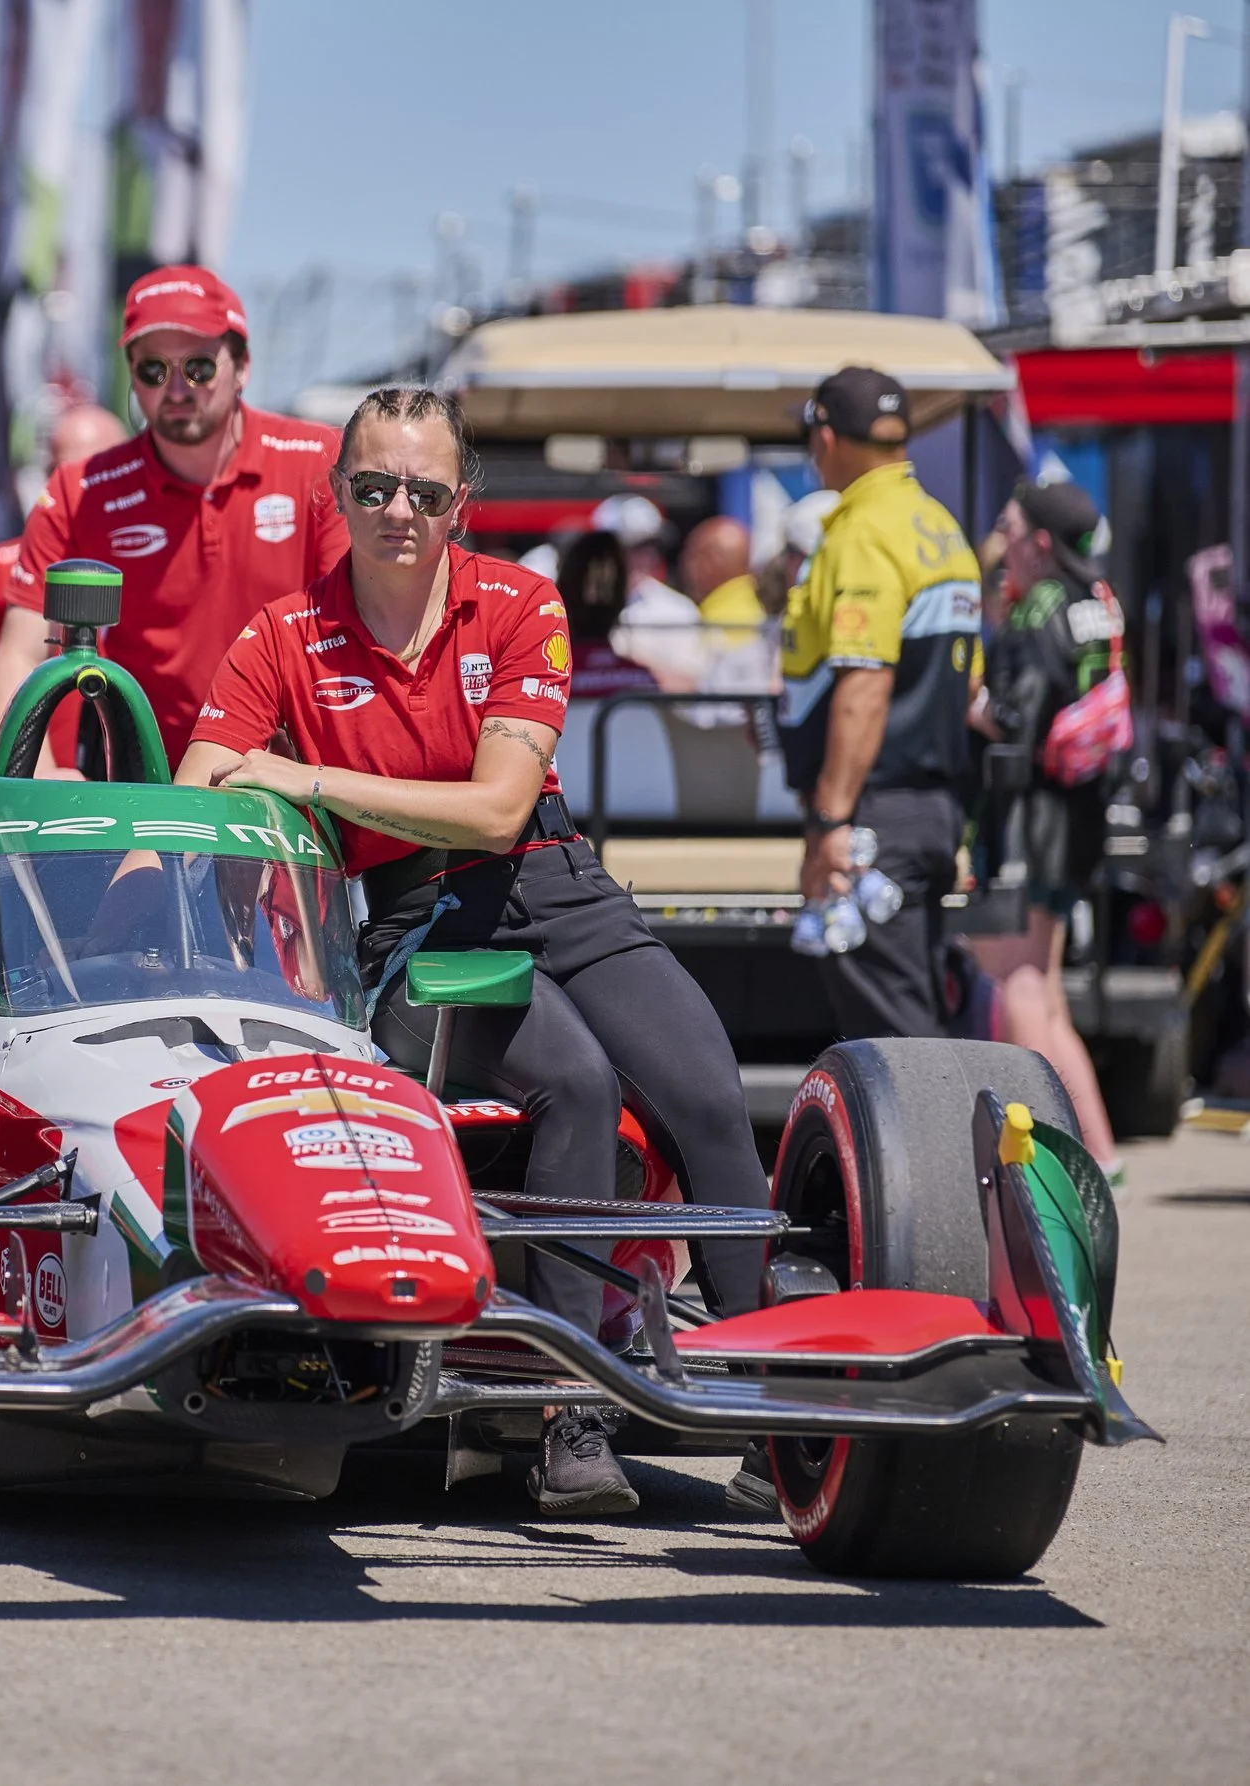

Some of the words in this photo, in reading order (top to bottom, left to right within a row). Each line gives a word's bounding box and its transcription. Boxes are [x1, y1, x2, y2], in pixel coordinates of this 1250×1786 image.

[471, 662, 491, 672] NTT
[316, 685, 377, 700] PREMA
[208, 707, 226, 721] ups
[788, 1074, 836, 1128] Firestone
[38, 1268, 63, 1307] BELL
